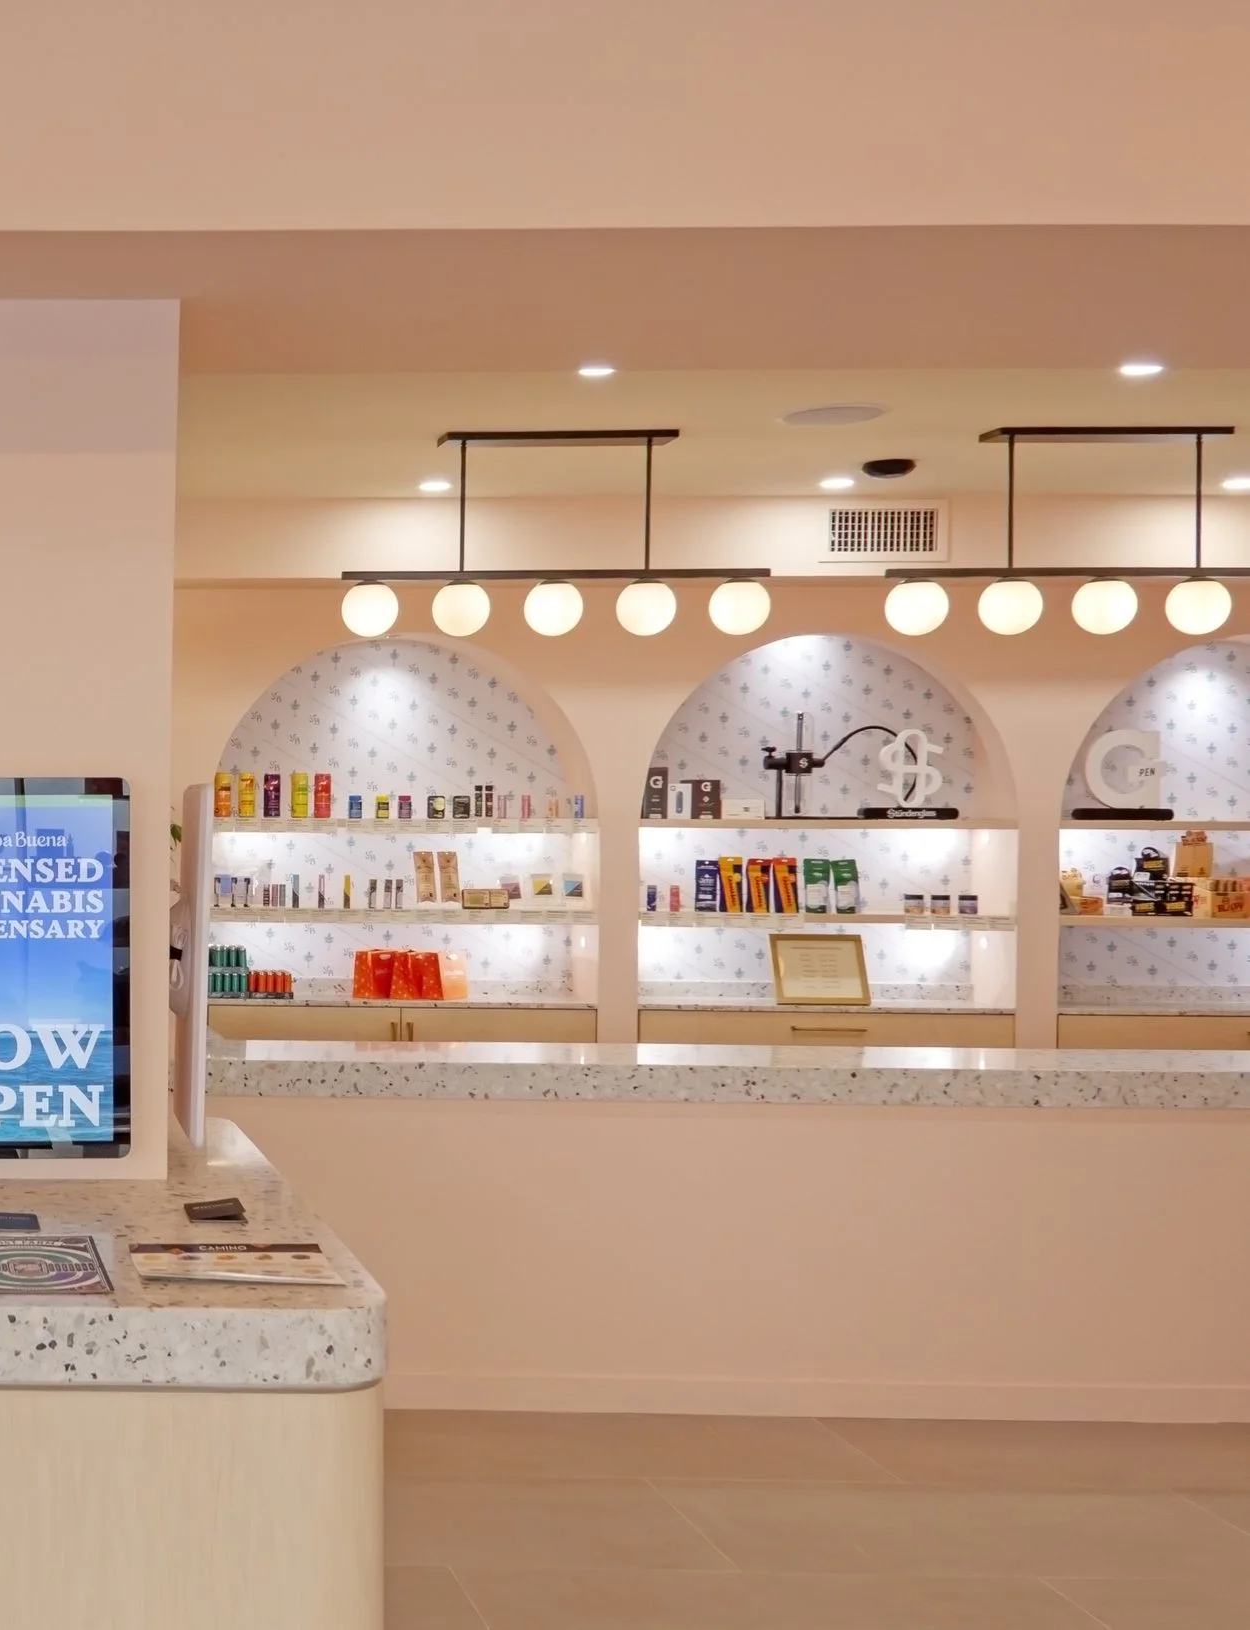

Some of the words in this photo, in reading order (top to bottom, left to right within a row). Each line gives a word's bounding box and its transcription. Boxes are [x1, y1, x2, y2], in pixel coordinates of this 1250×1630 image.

[1139, 768, 1156, 776] PEN
[649, 776, 664, 789] G
[700, 782, 712, 792] G
[15, 831, 66, 848] Buena
